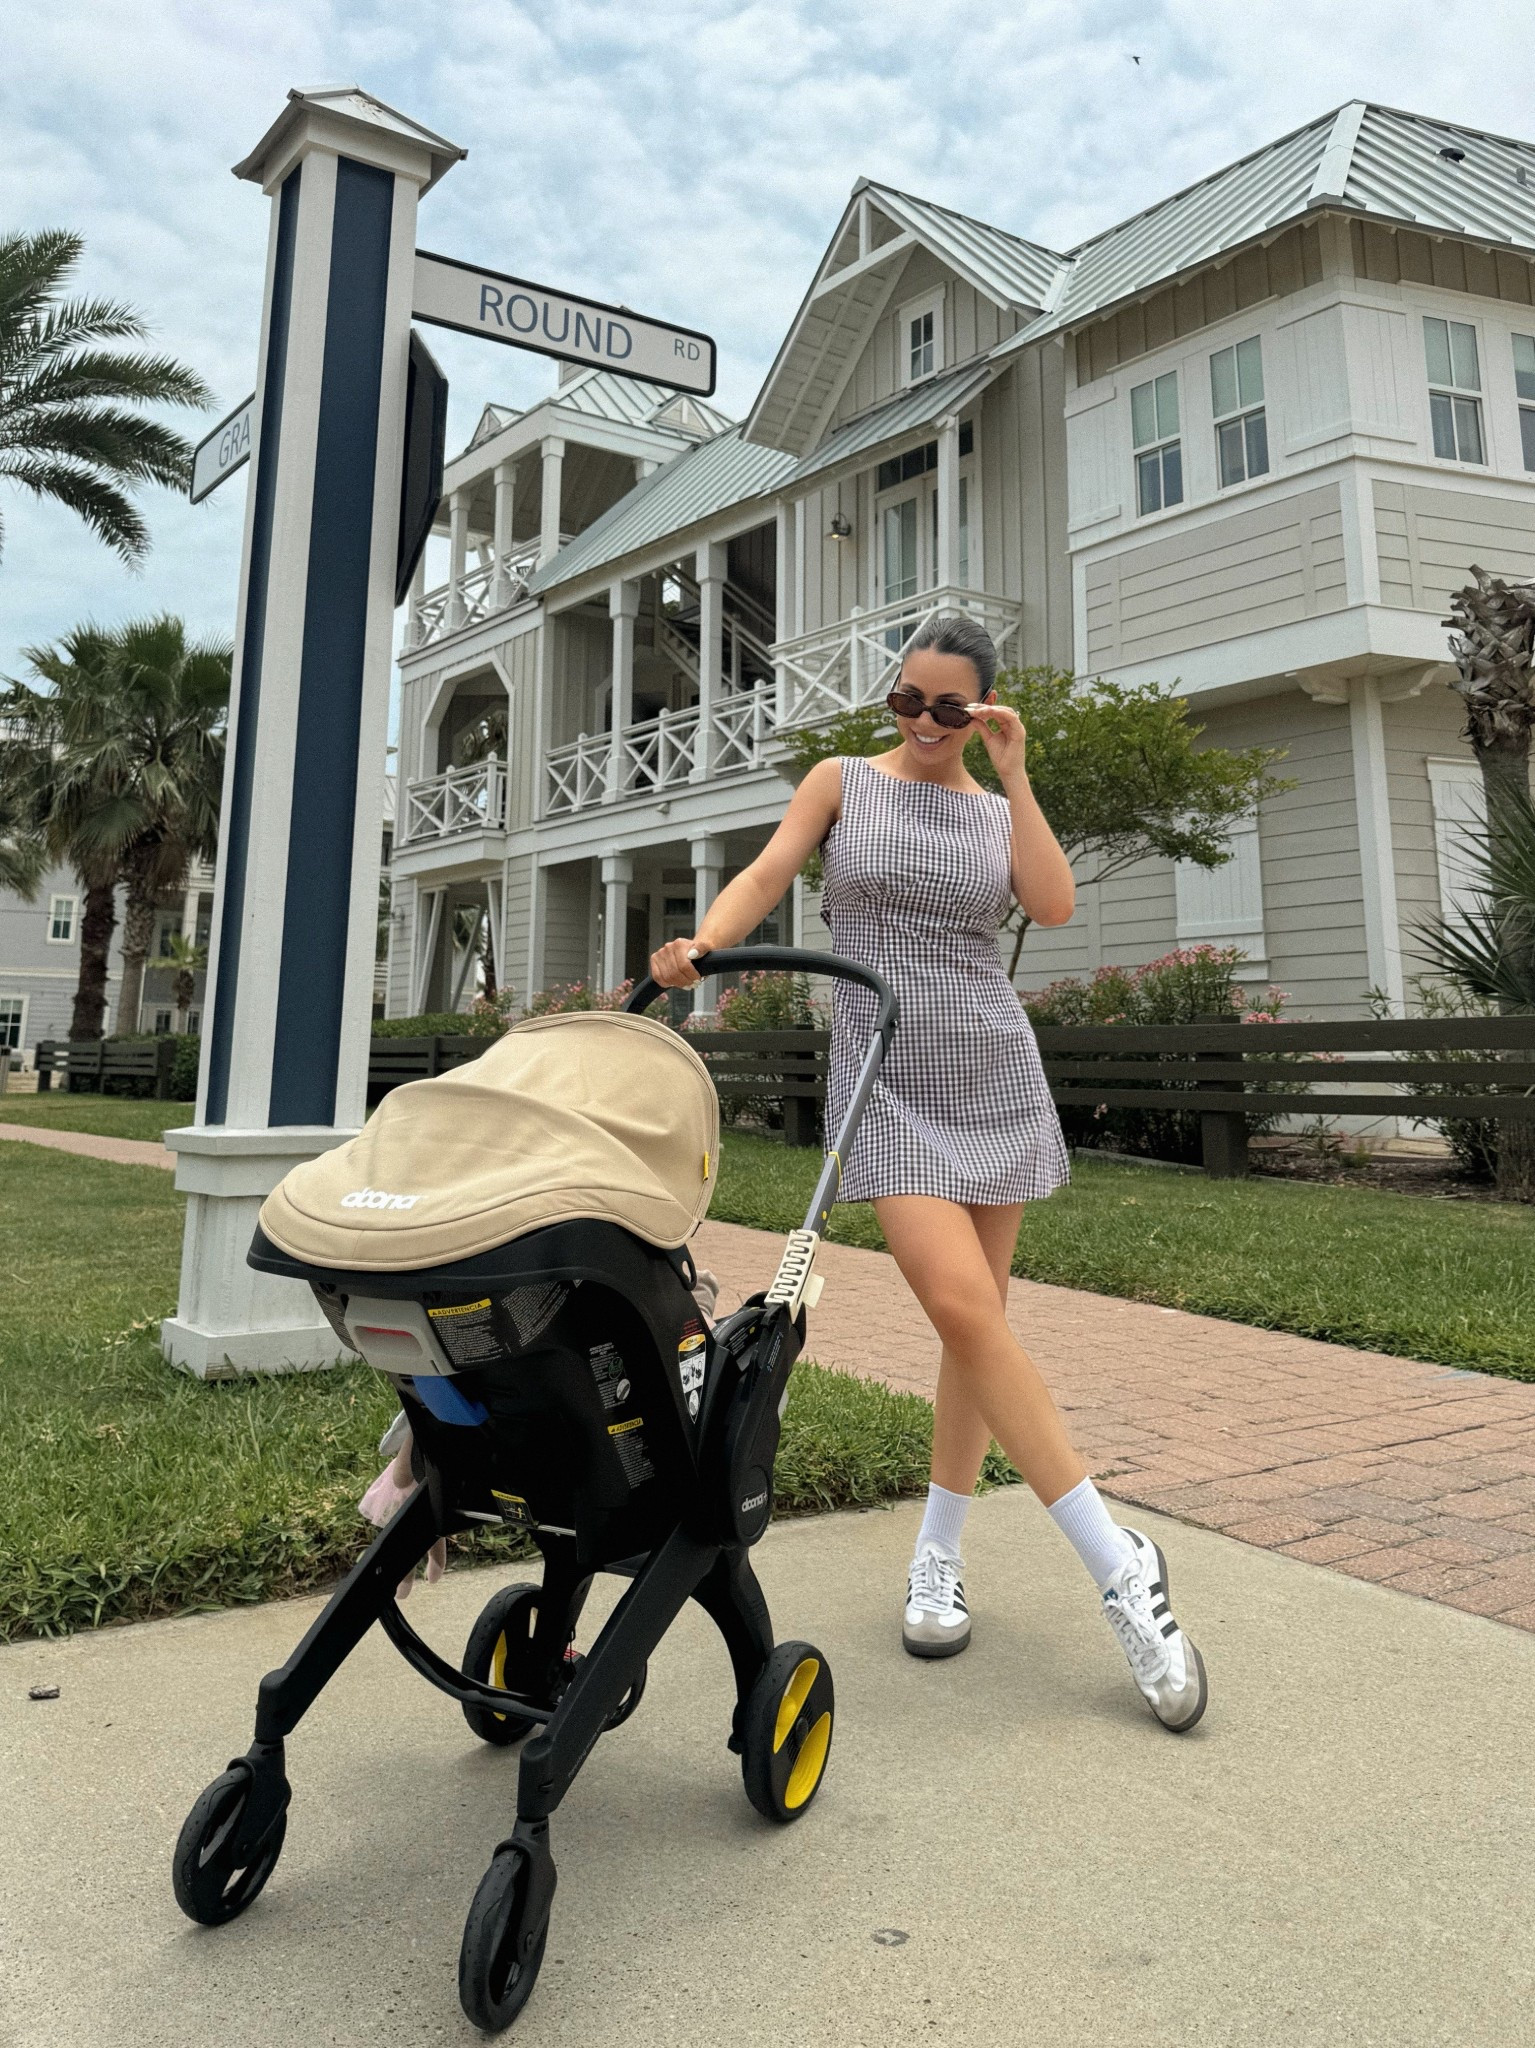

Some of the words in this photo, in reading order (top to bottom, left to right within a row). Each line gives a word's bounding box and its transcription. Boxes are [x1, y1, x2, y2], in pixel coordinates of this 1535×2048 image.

[479, 284, 633, 360] ROUND
[674, 338, 701, 361] RD
[219, 413, 250, 468] GRA
[437, 1303, 483, 1316] ADVERTENCIA
